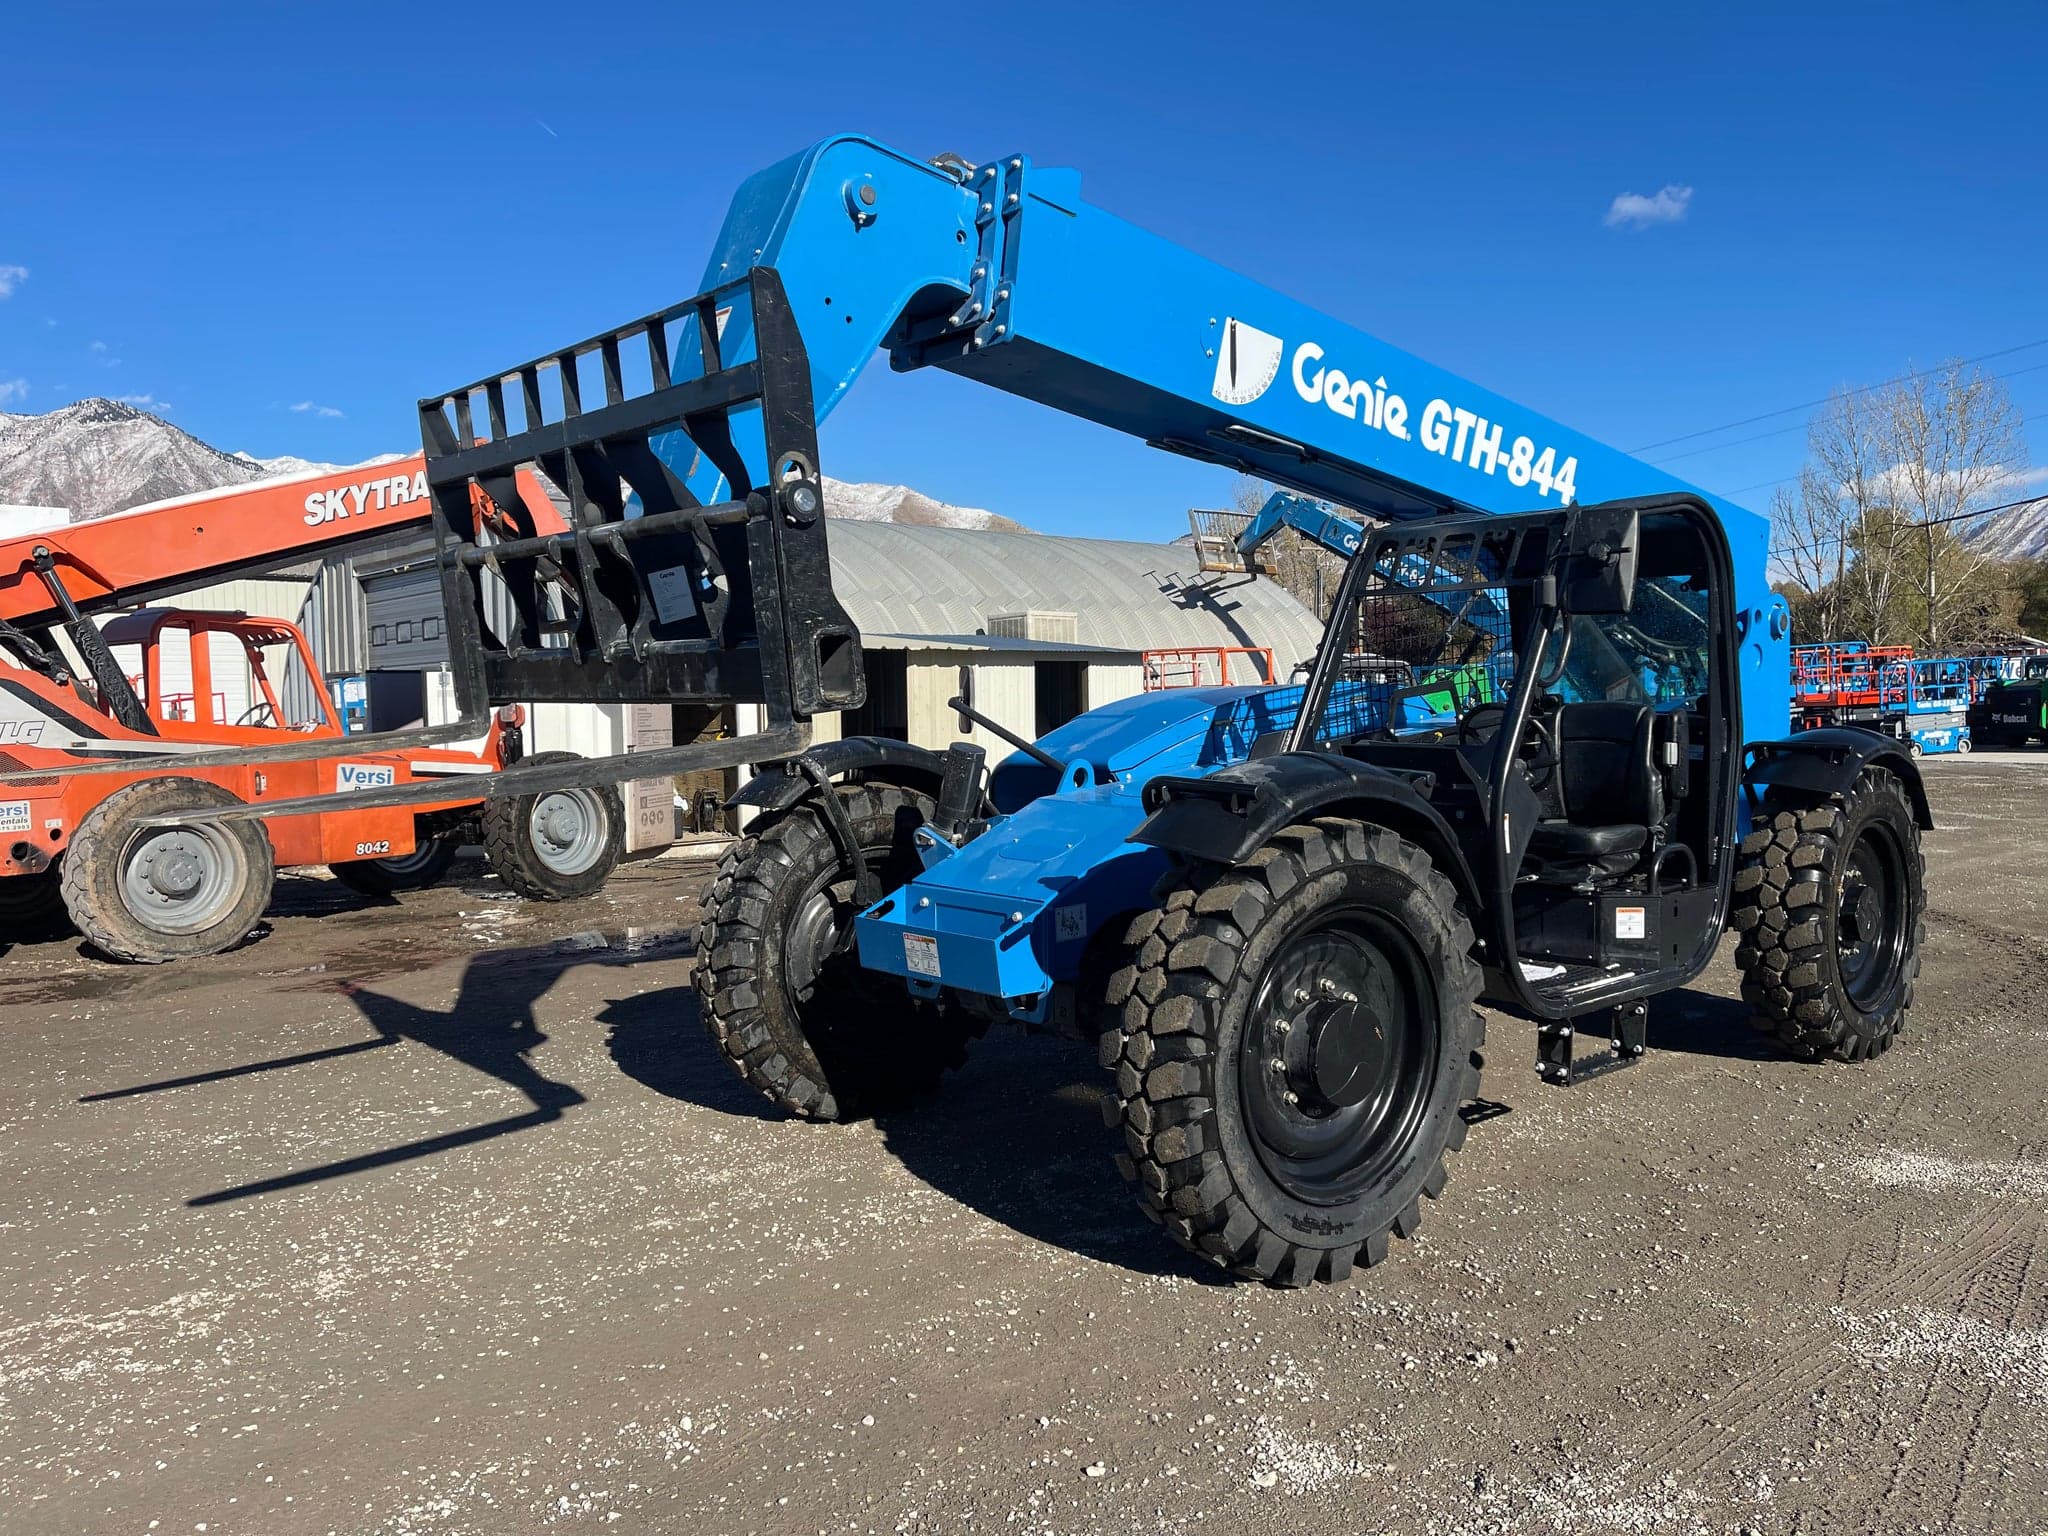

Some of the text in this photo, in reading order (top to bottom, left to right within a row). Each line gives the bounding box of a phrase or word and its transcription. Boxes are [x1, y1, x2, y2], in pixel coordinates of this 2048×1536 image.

[1292, 342, 1578, 505] Genie GTH-844
[303, 470, 431, 526] SKYTRA
[340, 766, 392, 785] Versi
[0, 802, 28, 816] ersi
[0, 816, 28, 826] entals
[355, 841, 390, 855] 8042
